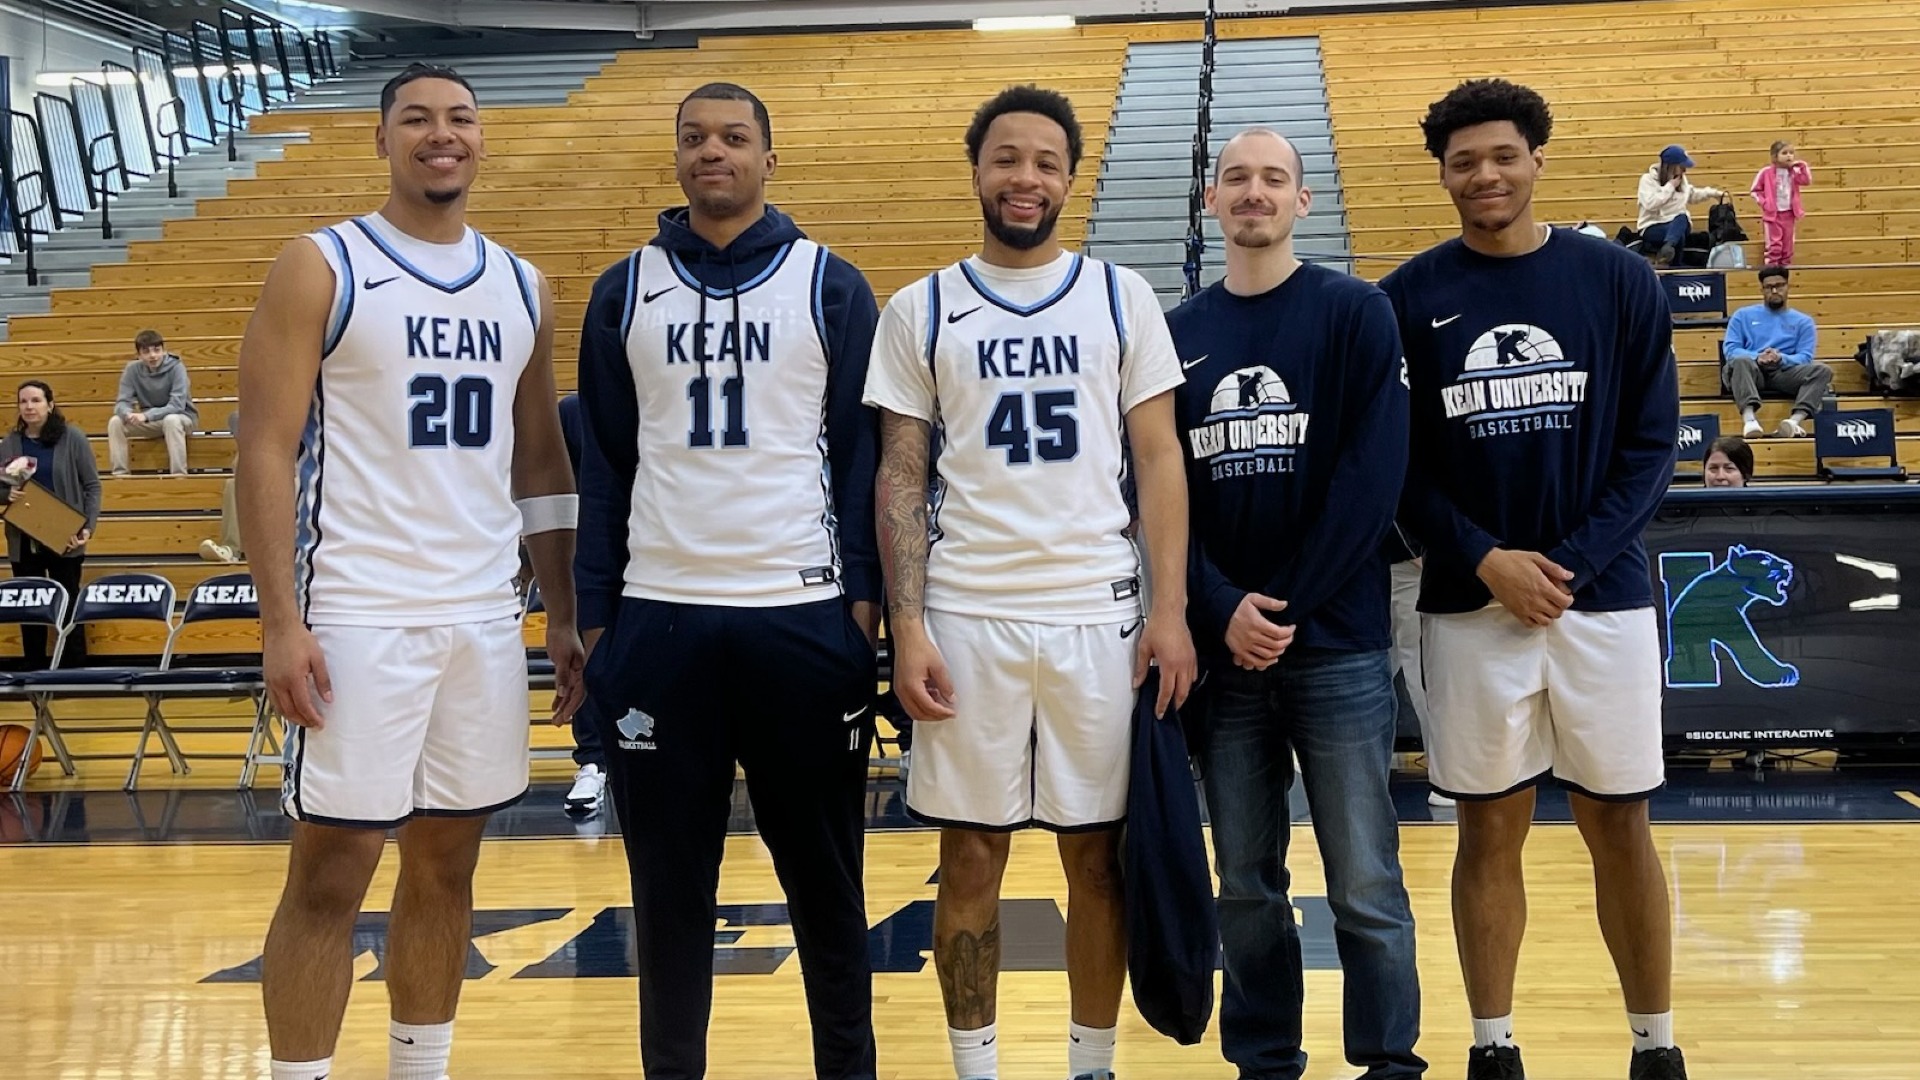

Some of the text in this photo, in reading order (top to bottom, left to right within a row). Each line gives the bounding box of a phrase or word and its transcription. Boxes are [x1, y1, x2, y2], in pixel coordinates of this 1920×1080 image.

[1679, 285, 1711, 298] KEAN
[405, 315, 502, 362] KEAN
[666, 320, 770, 365] KEAN
[977, 335, 1079, 379] KEAN
[407, 373, 493, 450] 20
[687, 377, 749, 449] 11
[1441, 372, 1589, 418] KEAN UNIVERSITY
[985, 389, 1080, 466] 45
[1188, 422, 1225, 459] KEAN
[1469, 415, 1572, 439] BASKETBALL
[1837, 424, 1876, 437] KEAN
[0, 588, 56, 607] EAN
[85, 585, 165, 603] KEAN
[1754, 729, 1834, 739] INTERACTIVE
